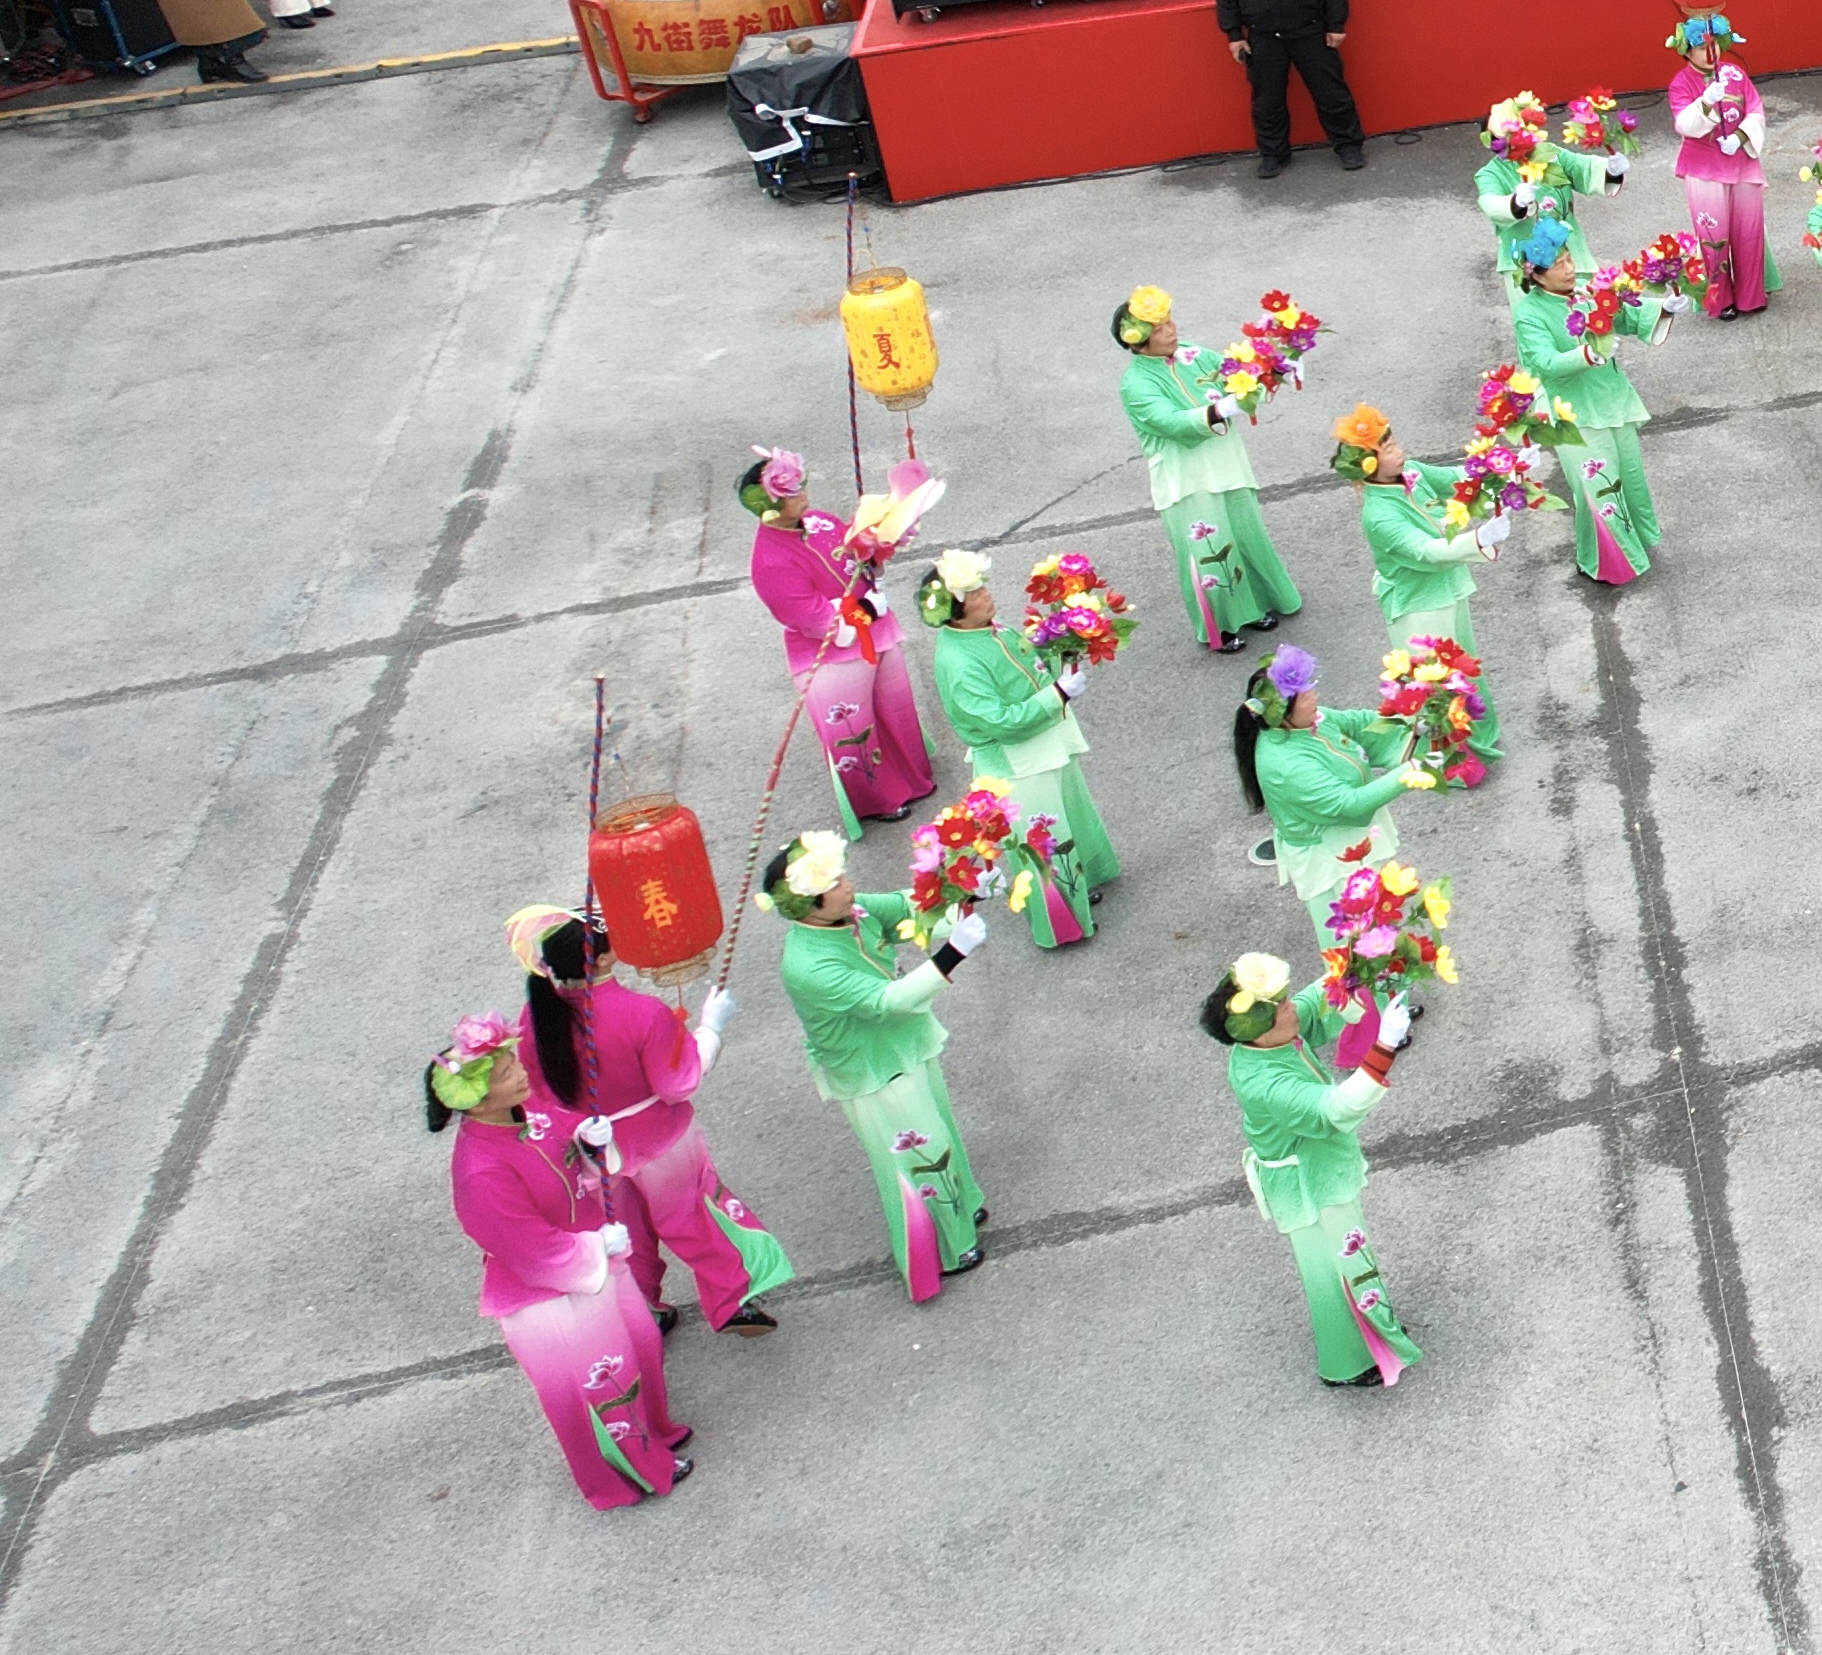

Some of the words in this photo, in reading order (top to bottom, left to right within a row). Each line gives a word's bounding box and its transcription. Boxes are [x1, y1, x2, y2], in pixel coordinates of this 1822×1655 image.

[632, 4, 801, 53] 九街舞龙队
[873, 333, 901, 370] 夏
[640, 877, 679, 929] 春
